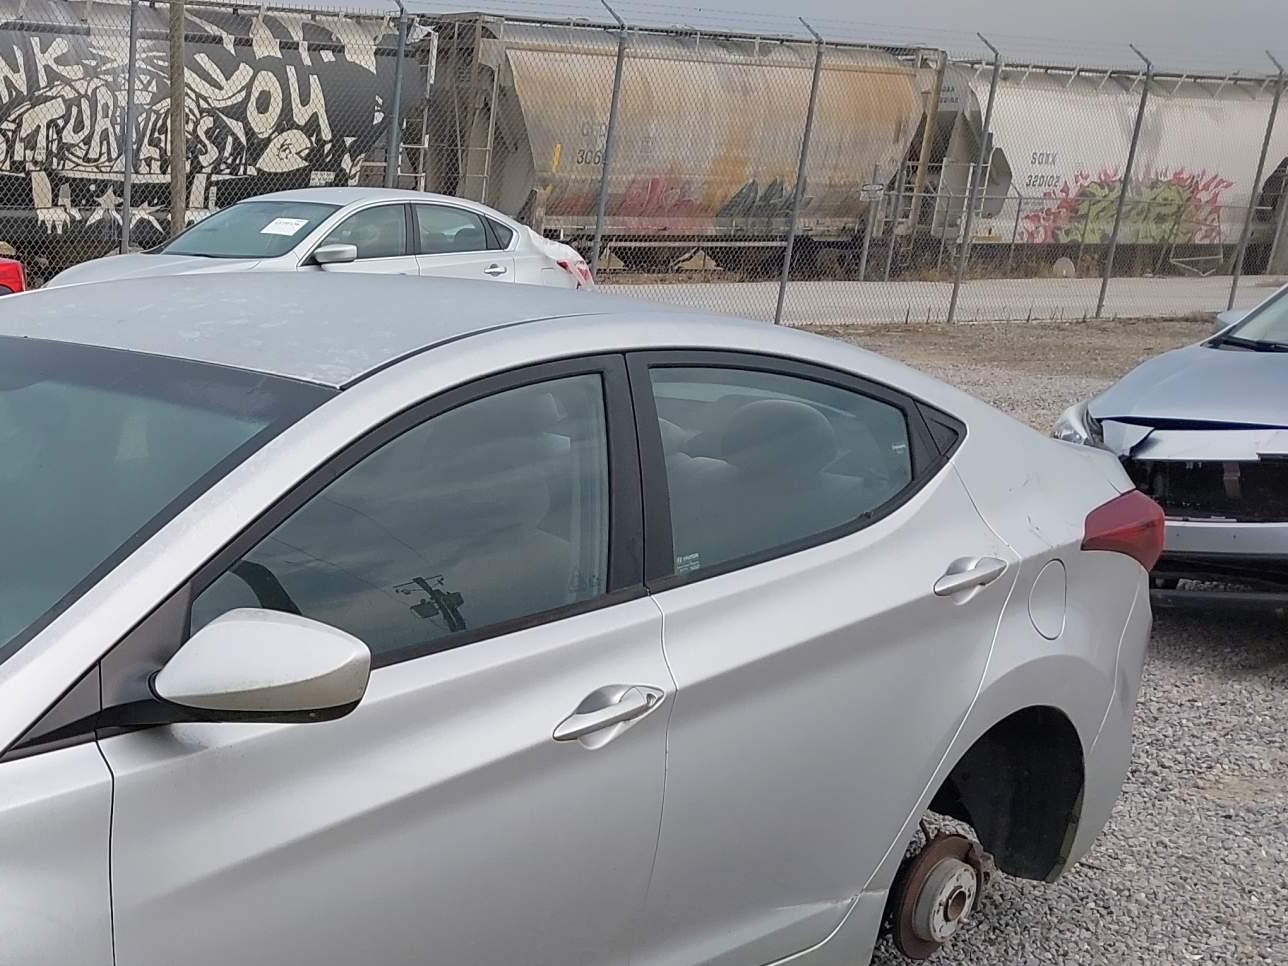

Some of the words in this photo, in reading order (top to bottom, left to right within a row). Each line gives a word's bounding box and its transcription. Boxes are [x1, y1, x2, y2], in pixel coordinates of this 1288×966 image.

[20, 86, 220, 168] TURLS
[183, 52, 333, 140] YOU
[576, 149, 604, 165] 306
